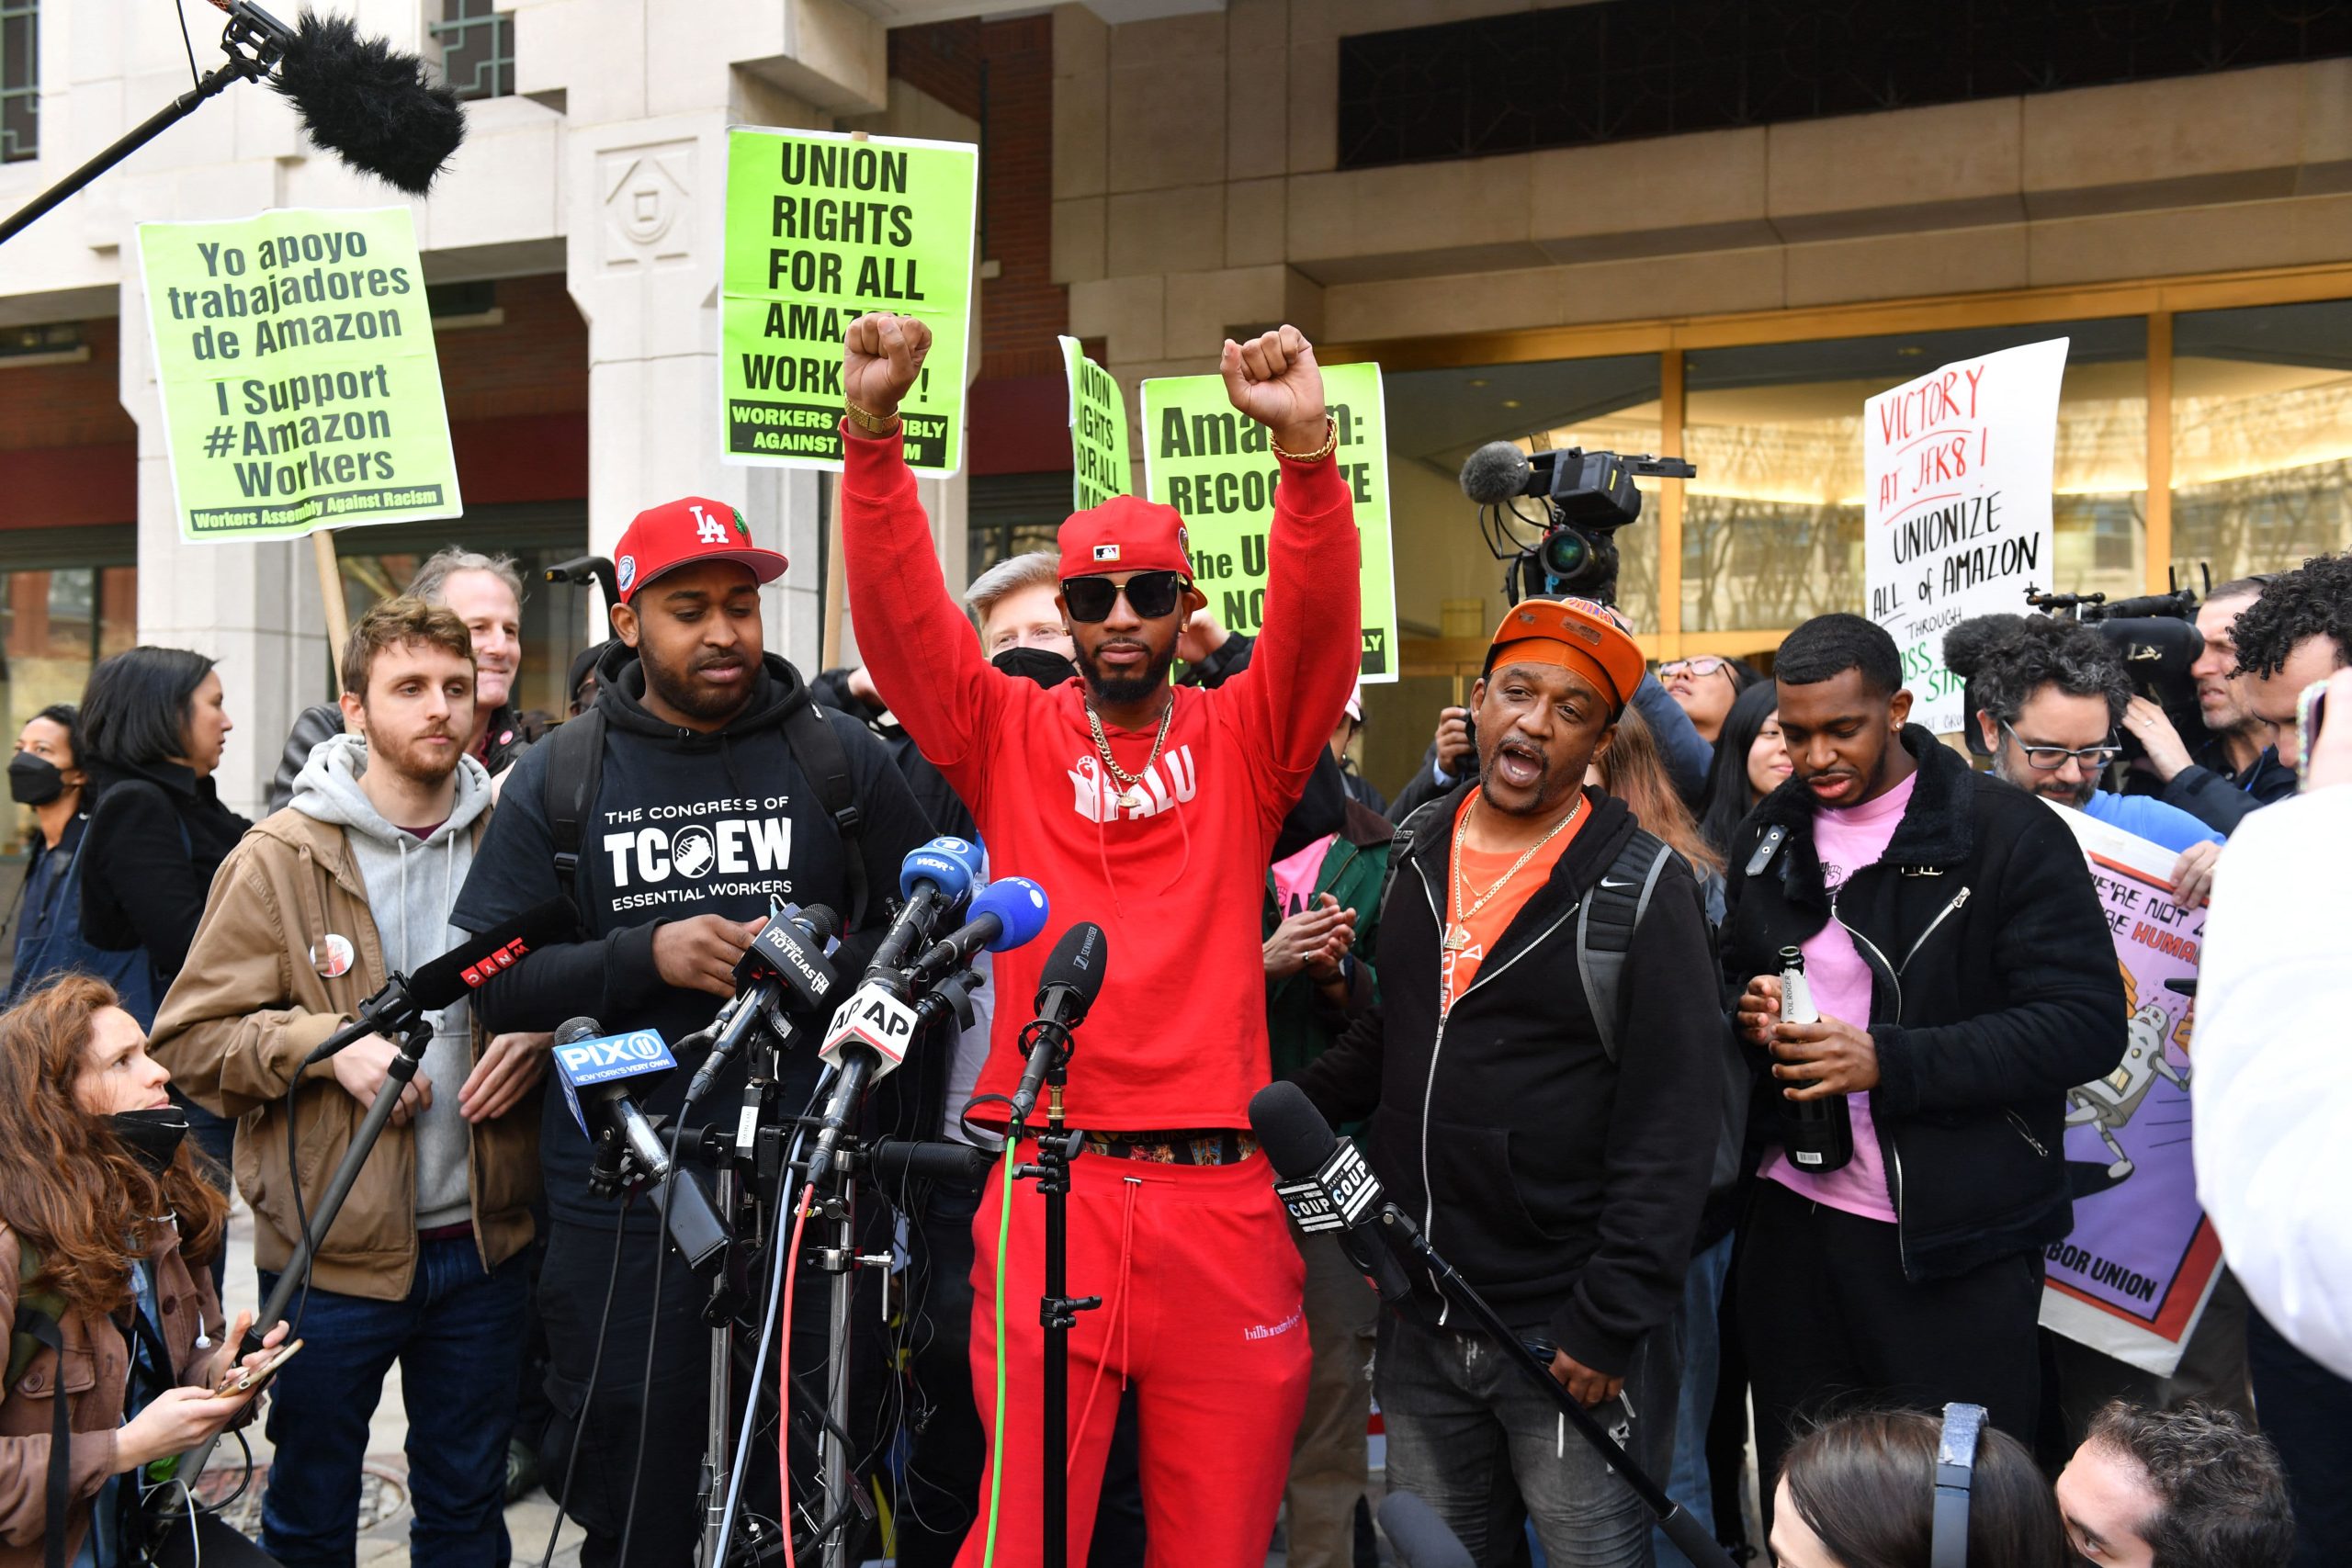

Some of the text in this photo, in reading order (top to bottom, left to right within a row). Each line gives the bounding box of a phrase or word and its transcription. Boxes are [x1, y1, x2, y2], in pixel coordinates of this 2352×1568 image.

[781, 141, 908, 194] UNION
[772, 195, 913, 247] RIGHTS
[197, 231, 368, 277] Yo apoyo
[768, 248, 925, 301] FOR ALL
[167, 266, 411, 320] trabajadores
[192, 308, 402, 360] de Amazon
[764, 302, 912, 344] AMA
[215, 364, 390, 416] I Support
[742, 353, 930, 402] WORK!
[1080, 364, 1111, 410] NION
[731, 405, 832, 430] WORKERS
[1080, 404, 1114, 452] IGHTS
[1880, 364, 1985, 446] VICTORY
[202, 409, 391, 458] #Amazon
[753, 431, 837, 455] AGAINST
[1160, 403, 1364, 458] Aman:
[233, 450, 395, 498] Workers
[1079, 443, 1097, 482] OR
[194, 489, 437, 529] Workers Assembly Against Racism
[1169, 462, 1373, 515] RECOE
[1879, 469, 1903, 513] AT
[689, 505, 729, 544] LA
[1893, 491, 2002, 565] UNIONIZE
[1872, 582, 1905, 622] ALL
[1942, 532, 2040, 599] AMAZON
[1223, 588, 1266, 630] NO
[1905, 607, 1963, 641] THROUGH
[1900, 641, 1933, 683] ASS
[605, 795, 789, 825] THE CONGRESS OF
[916, 857, 949, 872] WDR
[612, 880, 793, 912] ESSENTIAL WORKERS
[2092, 874, 2189, 928] E'RE NOT
[773, 926, 805, 955] SPECTRUM
[1080, 926, 1099, 957] SENNHEISER
[2132, 920, 2199, 966] HUMA
[828, 998, 864, 1038] AP
[863, 1000, 910, 1036] AP
[576, 1058, 670, 1083] NEW YORK'S VERY OWN
[1332, 1160, 1367, 1206] COUP
[1288, 1198, 1330, 1217] COUP
[2045, 1240, 2157, 1303] BOR UNION
